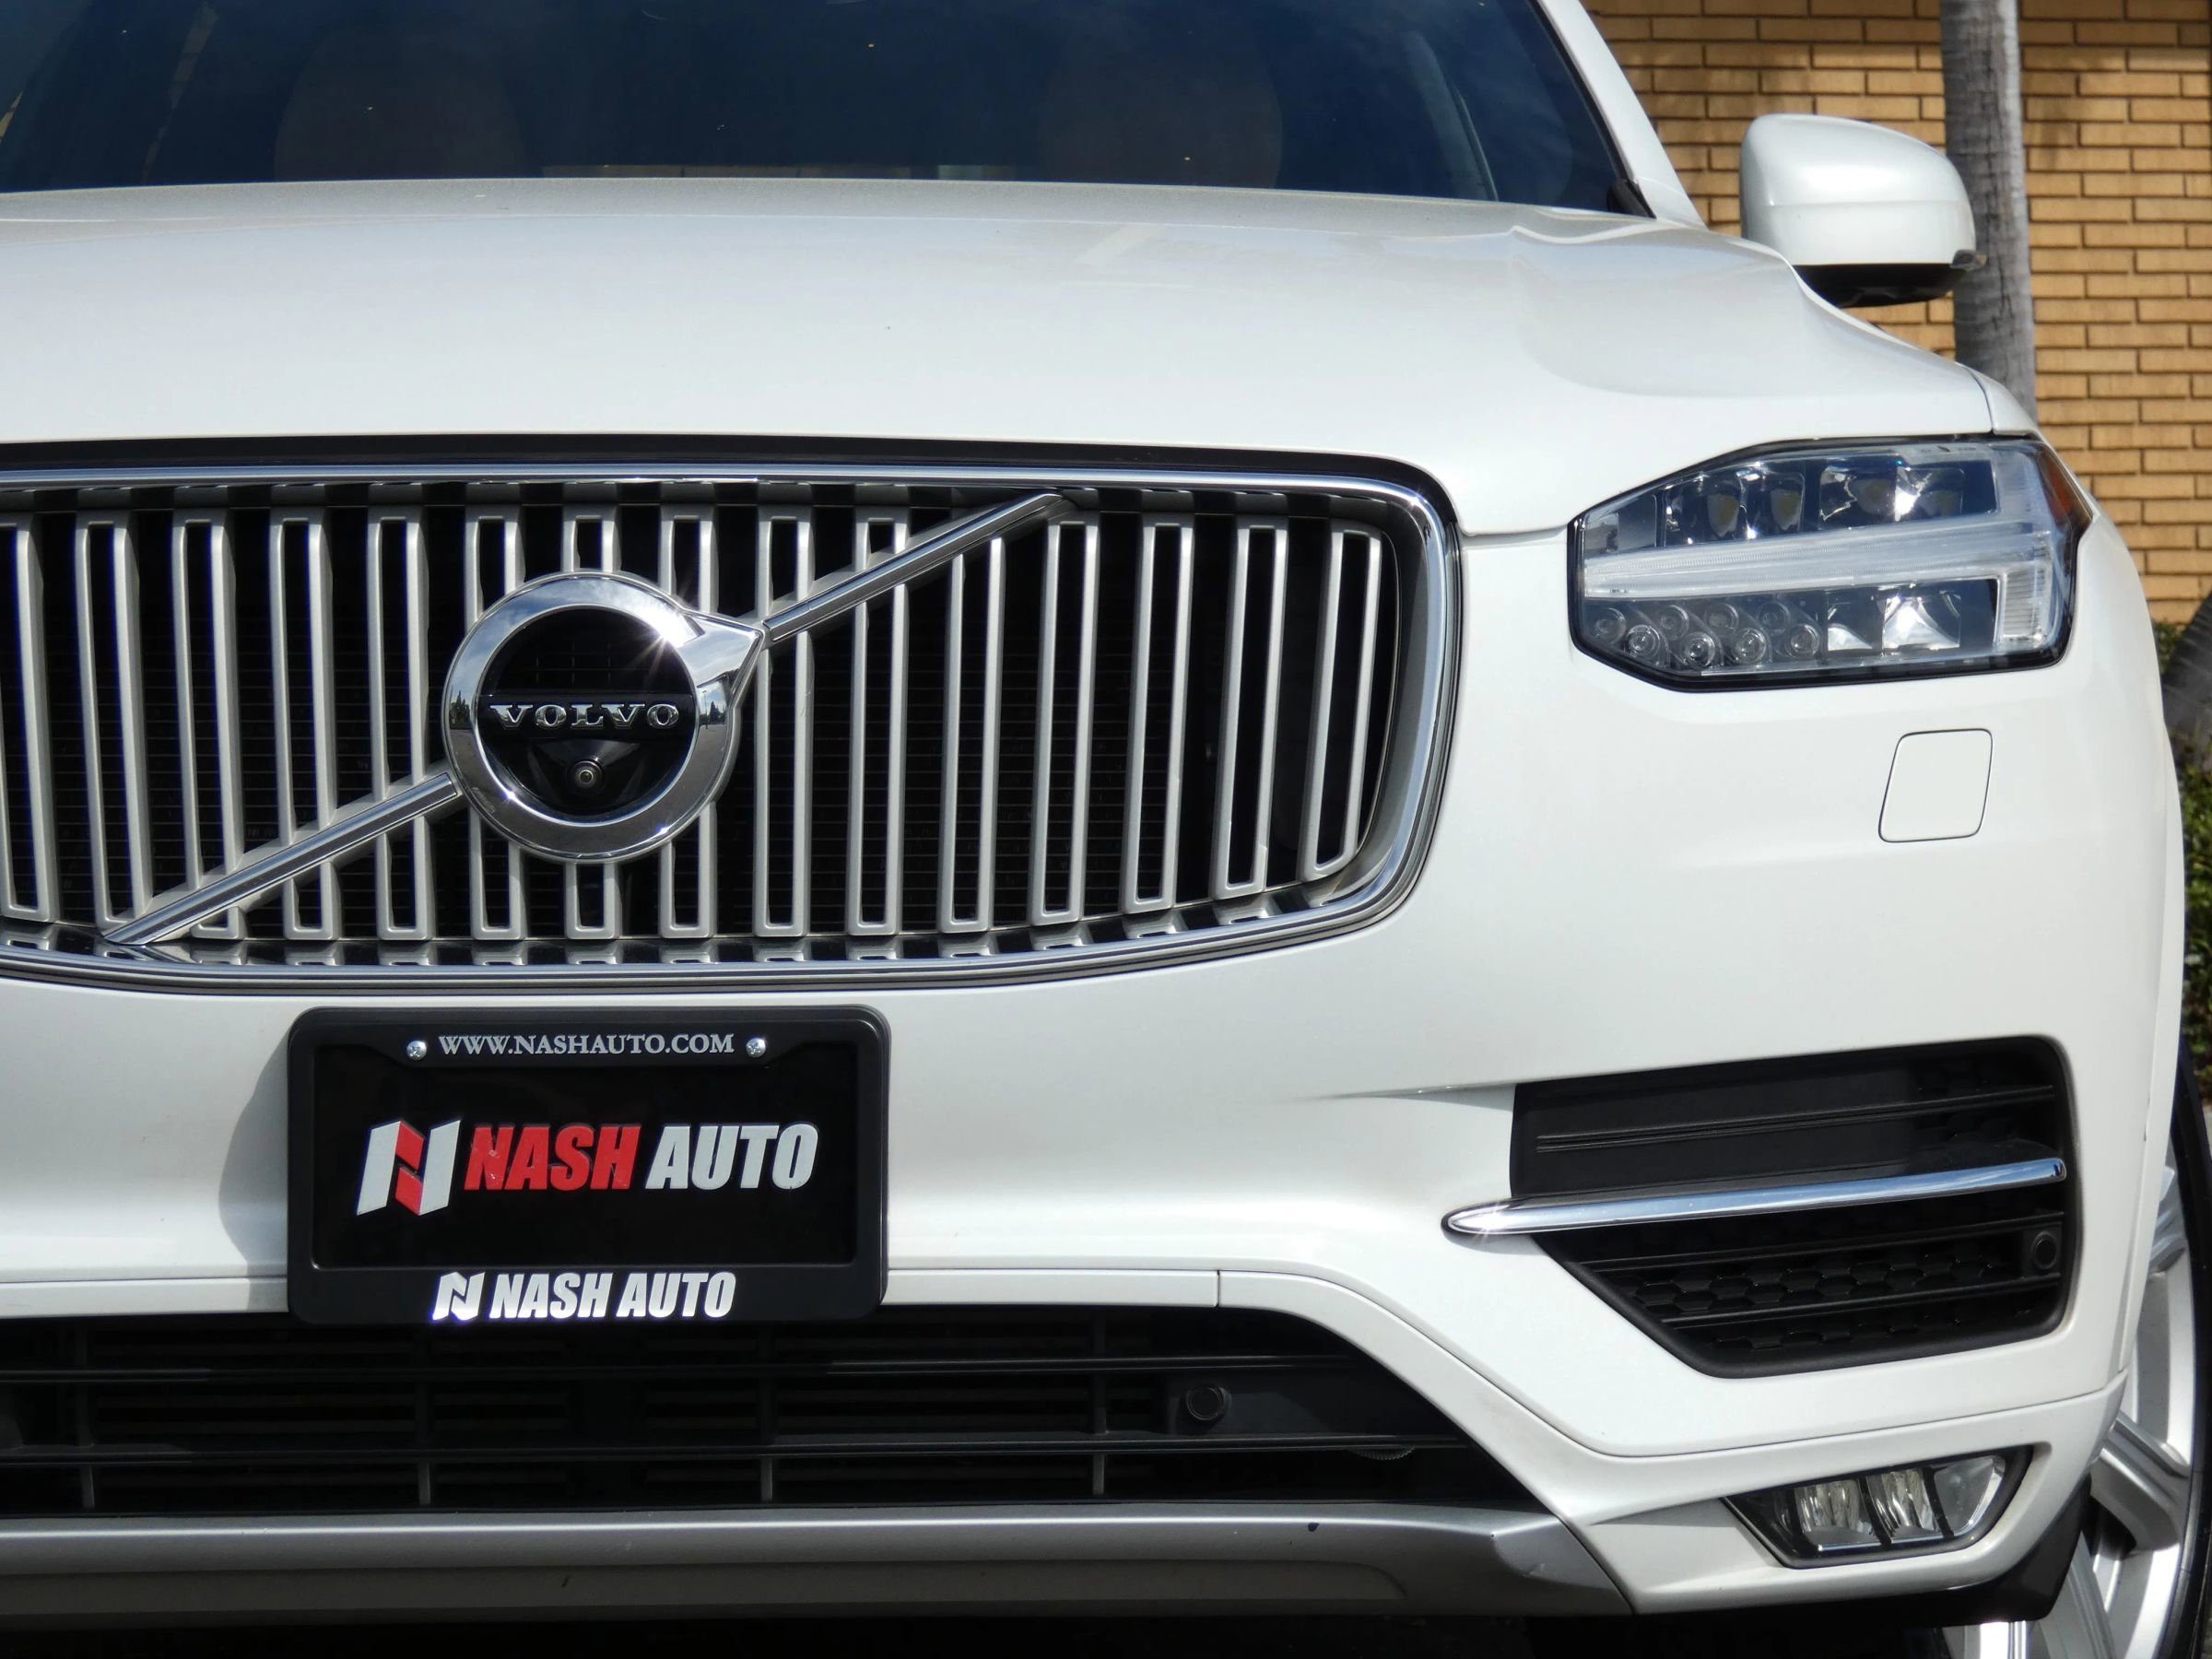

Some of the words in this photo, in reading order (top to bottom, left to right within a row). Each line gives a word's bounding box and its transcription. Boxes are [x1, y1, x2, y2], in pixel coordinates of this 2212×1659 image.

[489, 703, 679, 728] VOLVO
[438, 1033, 735, 1055] WWW.NASHAUTO.COM
[464, 1124, 641, 1191] NASH
[645, 1123, 819, 1191] AUTO
[488, 1272, 612, 1319] NASH
[616, 1271, 736, 1318] AUTO
